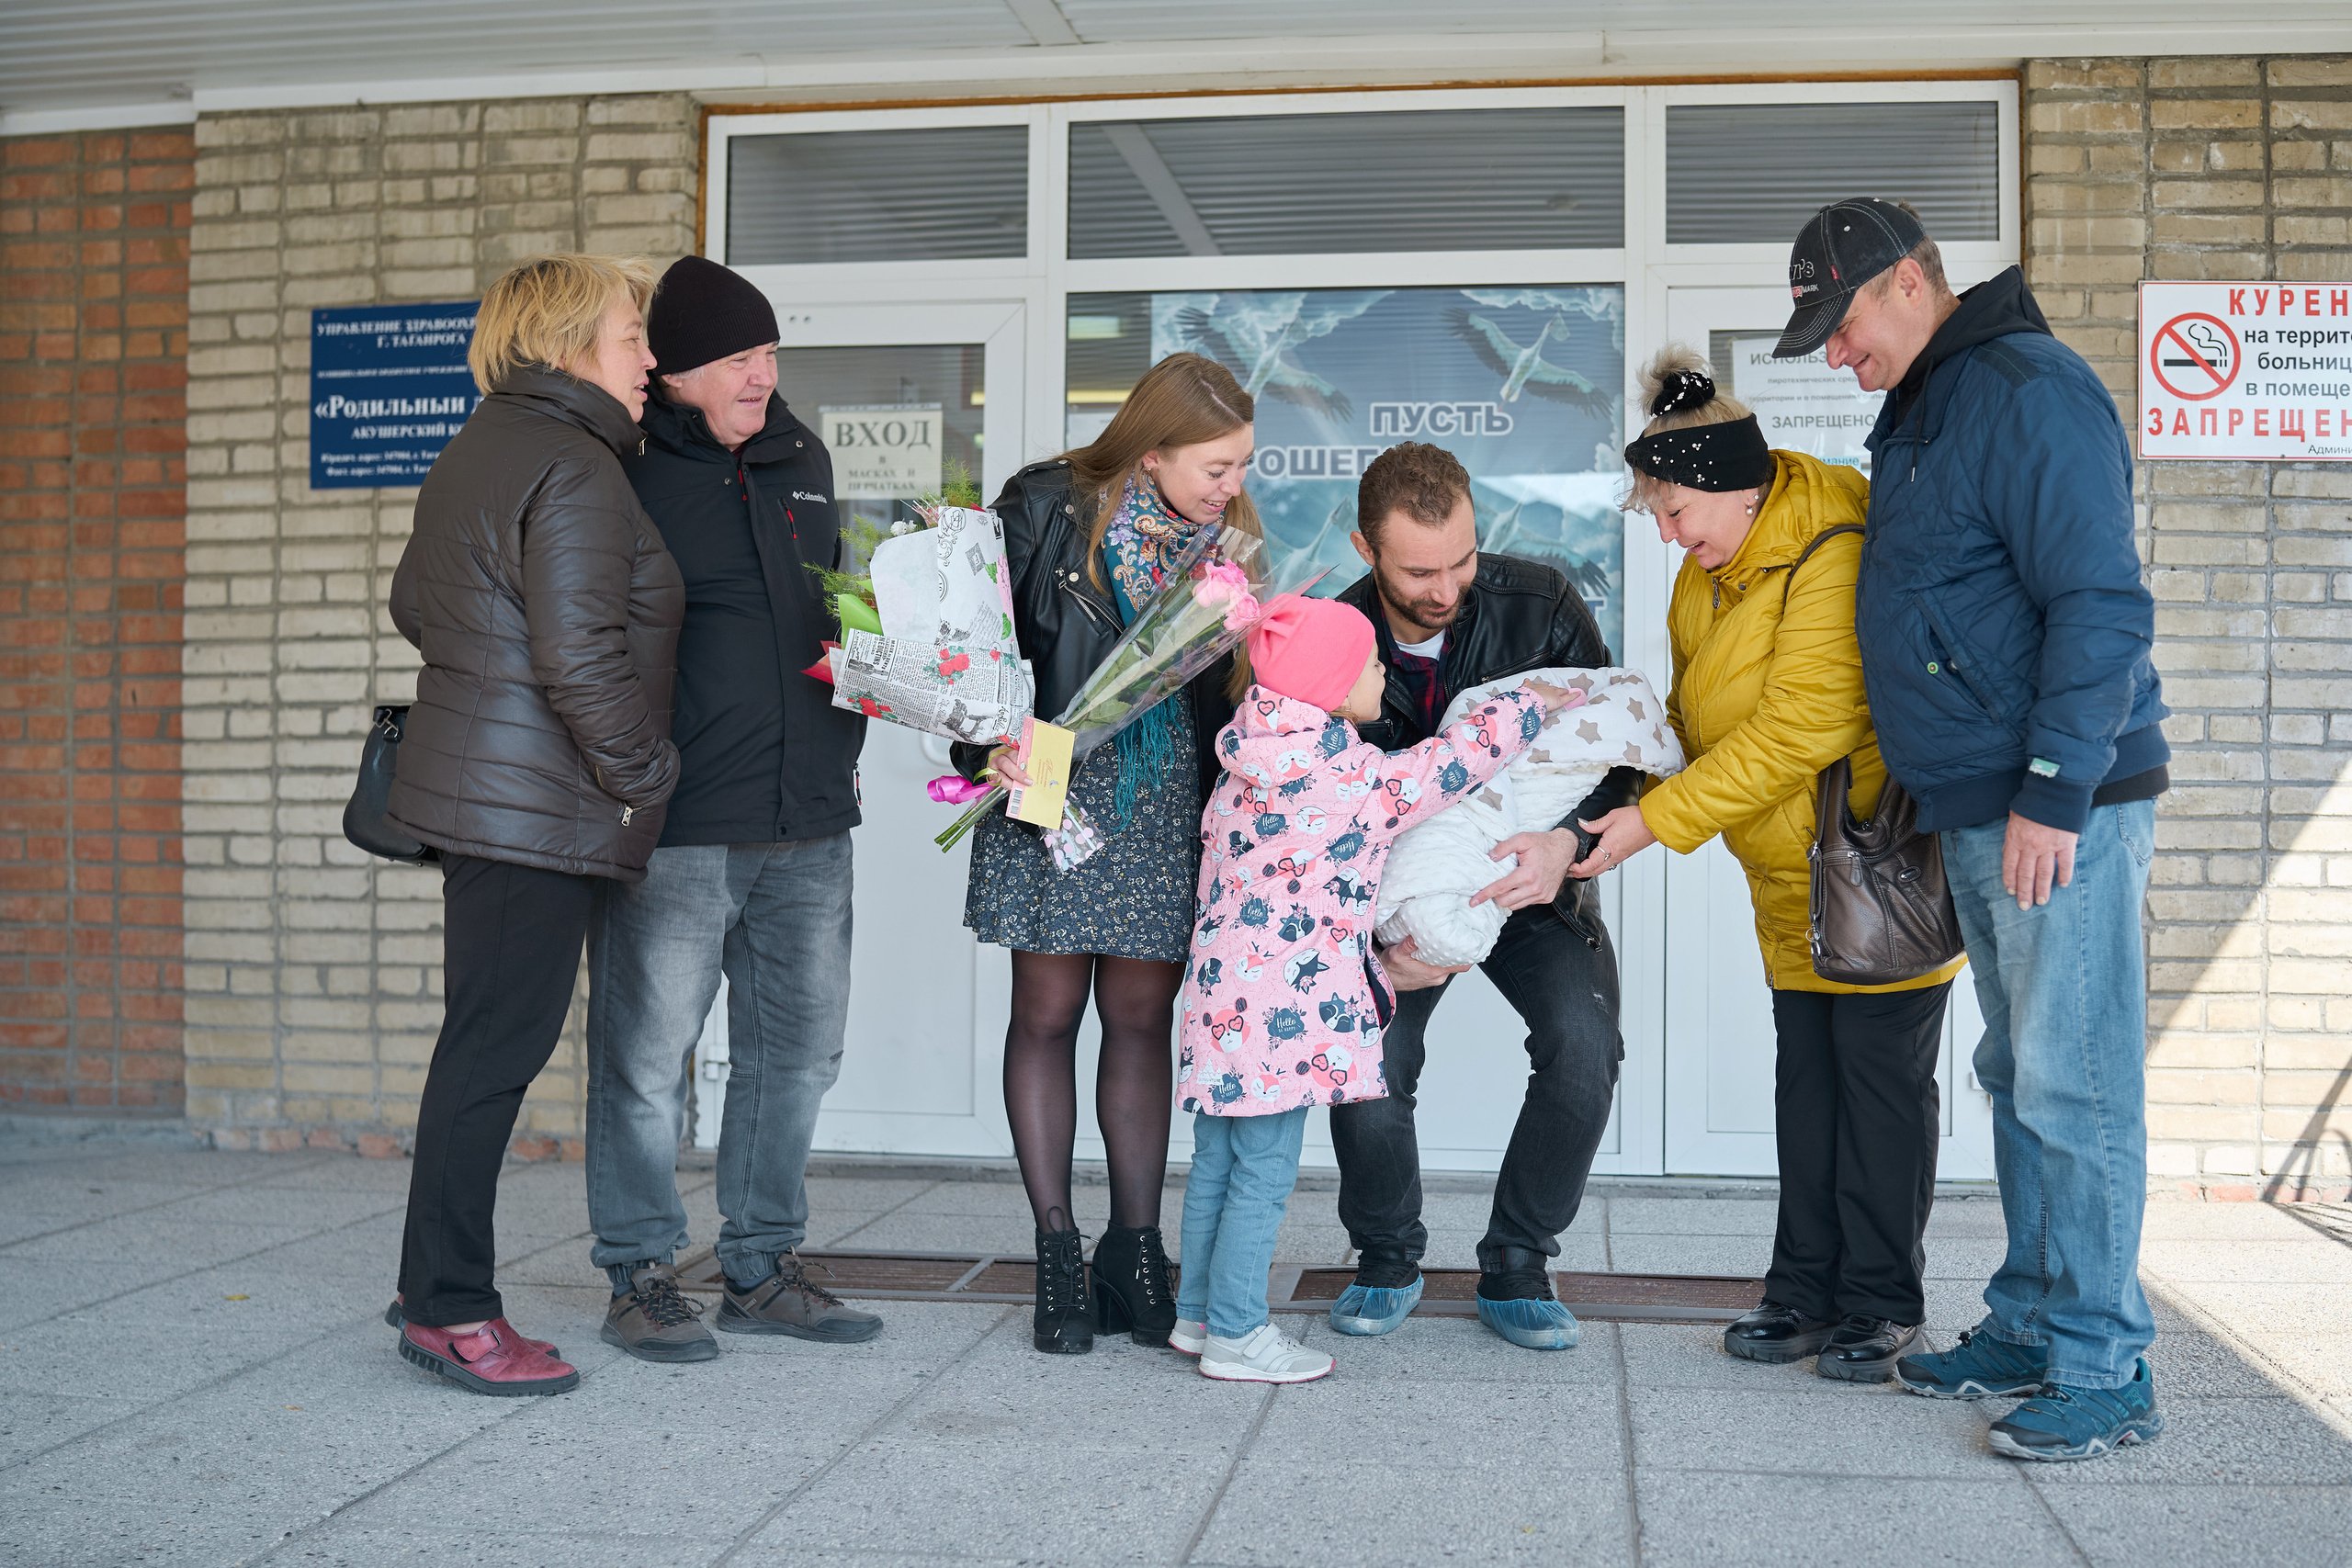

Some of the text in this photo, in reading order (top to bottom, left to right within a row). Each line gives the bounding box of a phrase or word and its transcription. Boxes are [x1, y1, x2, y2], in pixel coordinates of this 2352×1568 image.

[2229, 288, 2348, 316] КУРЕН
[317, 321, 402, 335] УПРАВЛЕНИЕ
[392, 332, 467, 348] ТАГАНРОГА
[2245, 330, 2352, 348] на террит
[2258, 352, 2352, 373] больниц
[2246, 382, 2351, 400] в помеще
[1370, 401, 1514, 436] ПУСТЬ
[1771, 414, 1875, 429] ЗАПРЕЩЕНО
[351, 422, 445, 440] АКУШЕРСКИЙ
[834, 420, 932, 451] ВХОД
[849, 468, 897, 479] МАСКАХ
[849, 481, 916, 491] ПЕРЧАТКАХ
[799, 491, 827, 504] Columbia
[1327, 732, 1338, 750] Hello
[1448, 771, 1460, 789] Hello
[1262, 815, 1280, 827] Hello
[1335, 840, 1355, 853] Hello
[1276, 1017, 1296, 1029] Hello
[1218, 1082, 1237, 1094] Hello
